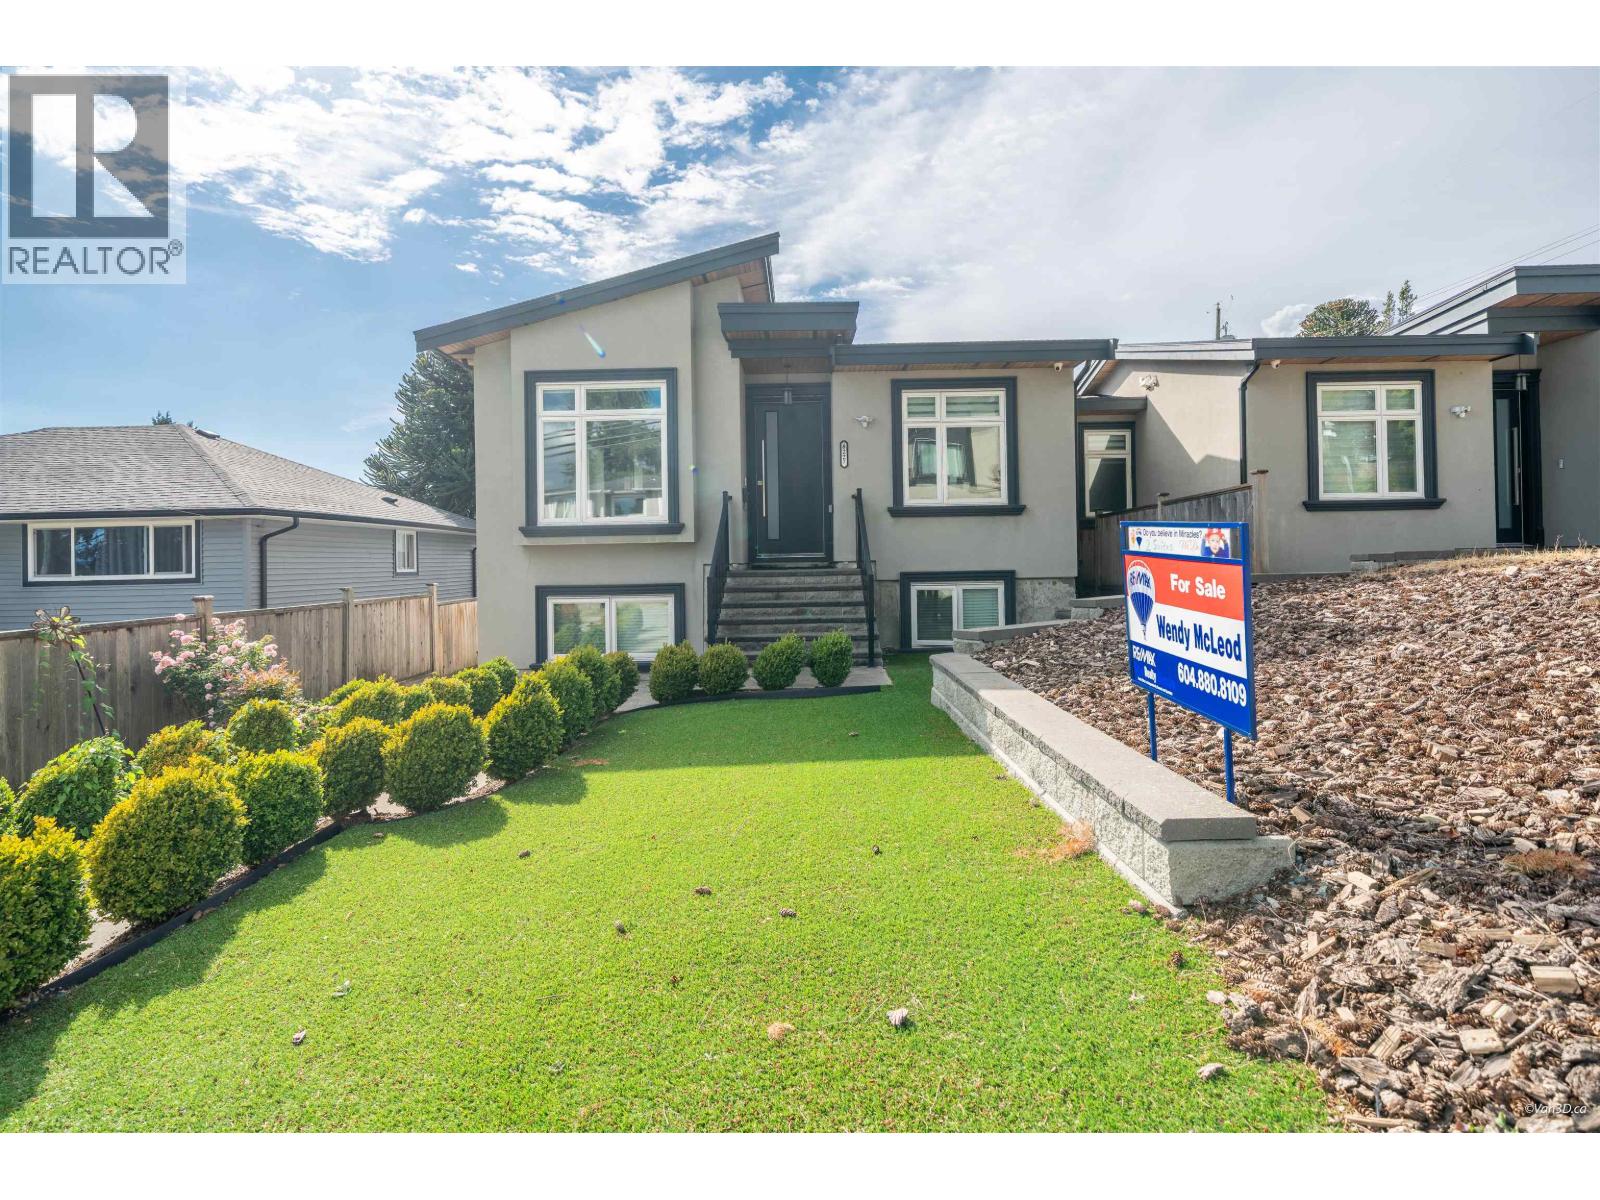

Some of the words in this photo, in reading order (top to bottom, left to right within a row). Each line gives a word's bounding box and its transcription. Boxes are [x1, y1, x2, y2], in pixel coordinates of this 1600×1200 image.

[1169, 573, 1191, 594] For
[1195, 576, 1226, 600] Sale
[1156, 614, 1191, 652] Wendy
[1193, 623, 1242, 662] McLeod
[1177, 662, 1247, 708] 604.880.8109
